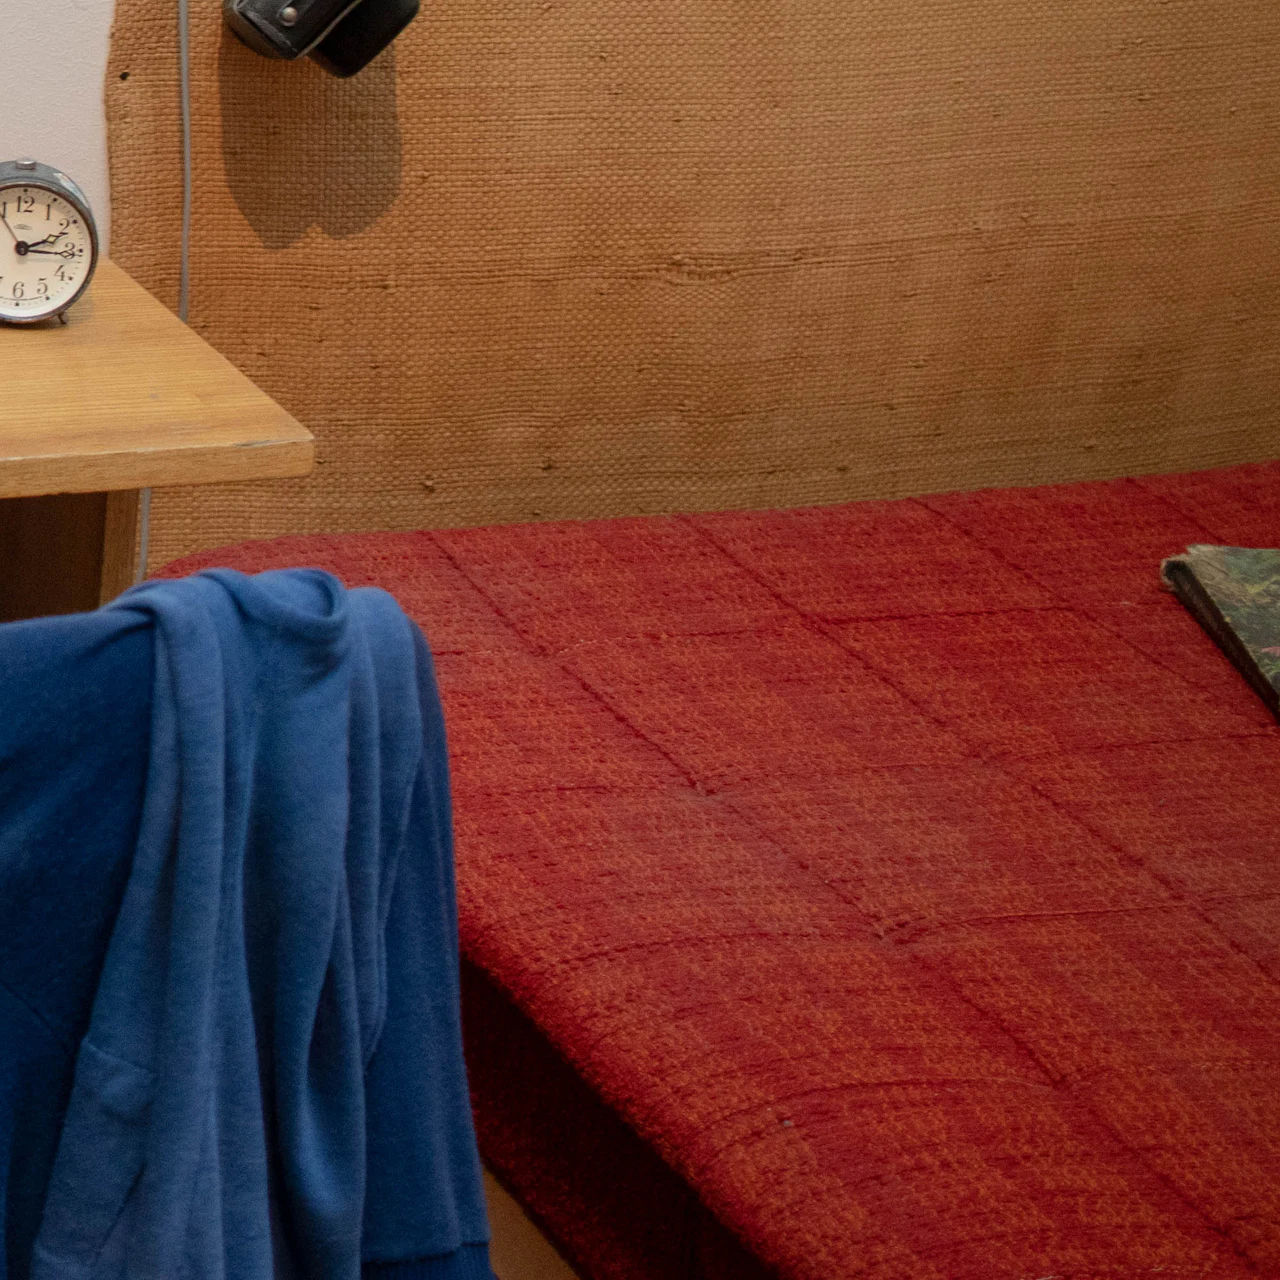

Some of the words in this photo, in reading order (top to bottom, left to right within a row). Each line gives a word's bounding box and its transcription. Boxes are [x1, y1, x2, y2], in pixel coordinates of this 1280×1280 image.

[16, 196, 35, 213] 12
[46, 204, 51, 220] 1
[59, 218, 69, 235] 2
[54, 265, 65, 281] 4
[13, 281, 24, 299] 6
[37, 278, 48, 294] 5
